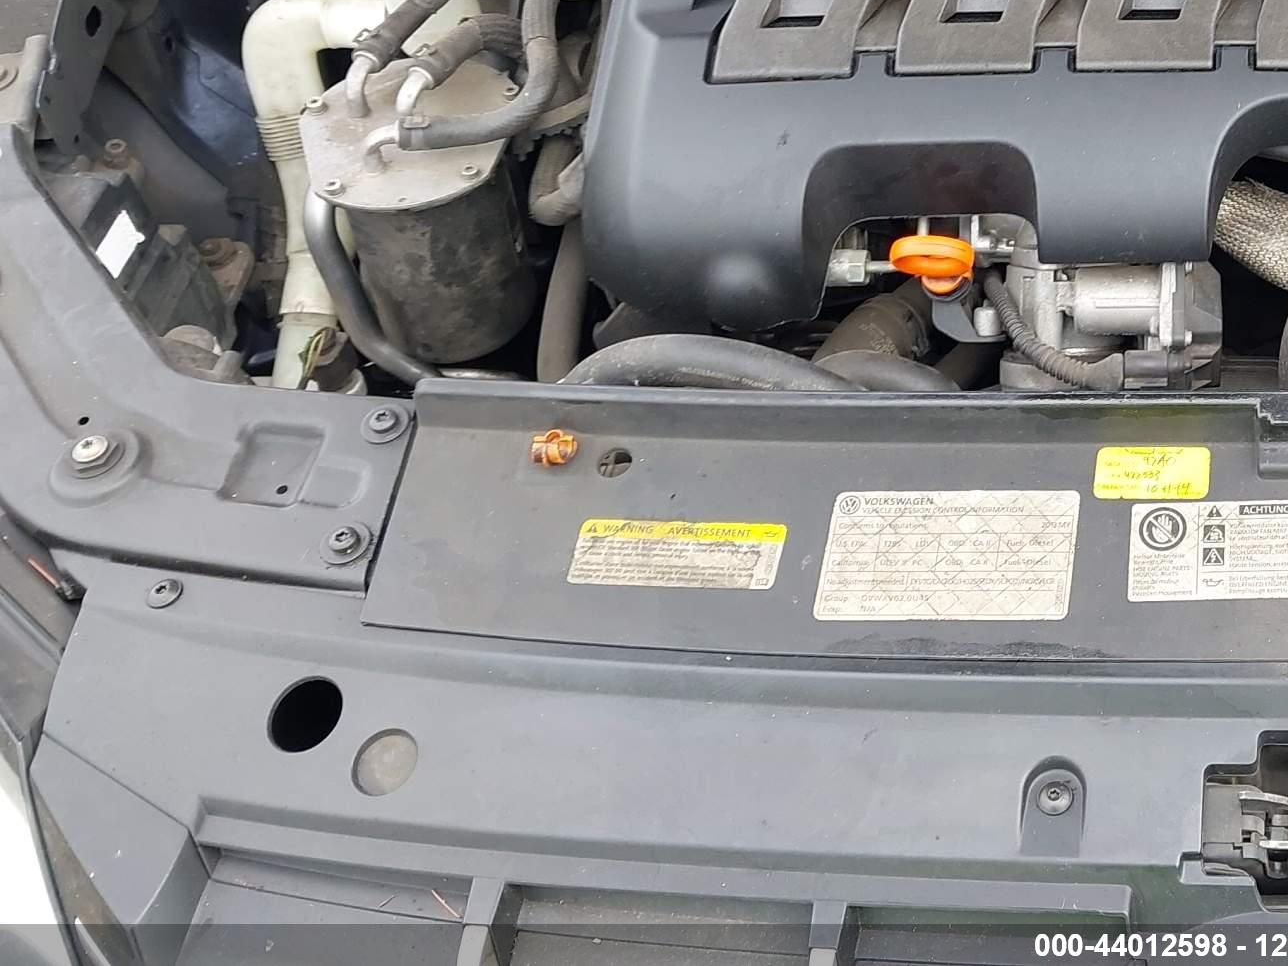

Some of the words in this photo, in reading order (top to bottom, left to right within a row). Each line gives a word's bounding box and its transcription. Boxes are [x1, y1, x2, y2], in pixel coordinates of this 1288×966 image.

[864, 497, 934, 506] VOLKSWAGEN
[932, 506, 967, 514] CONTROL
[602, 523, 654, 534] WARNING
[666, 525, 752, 538] AVERTISSEMENT
